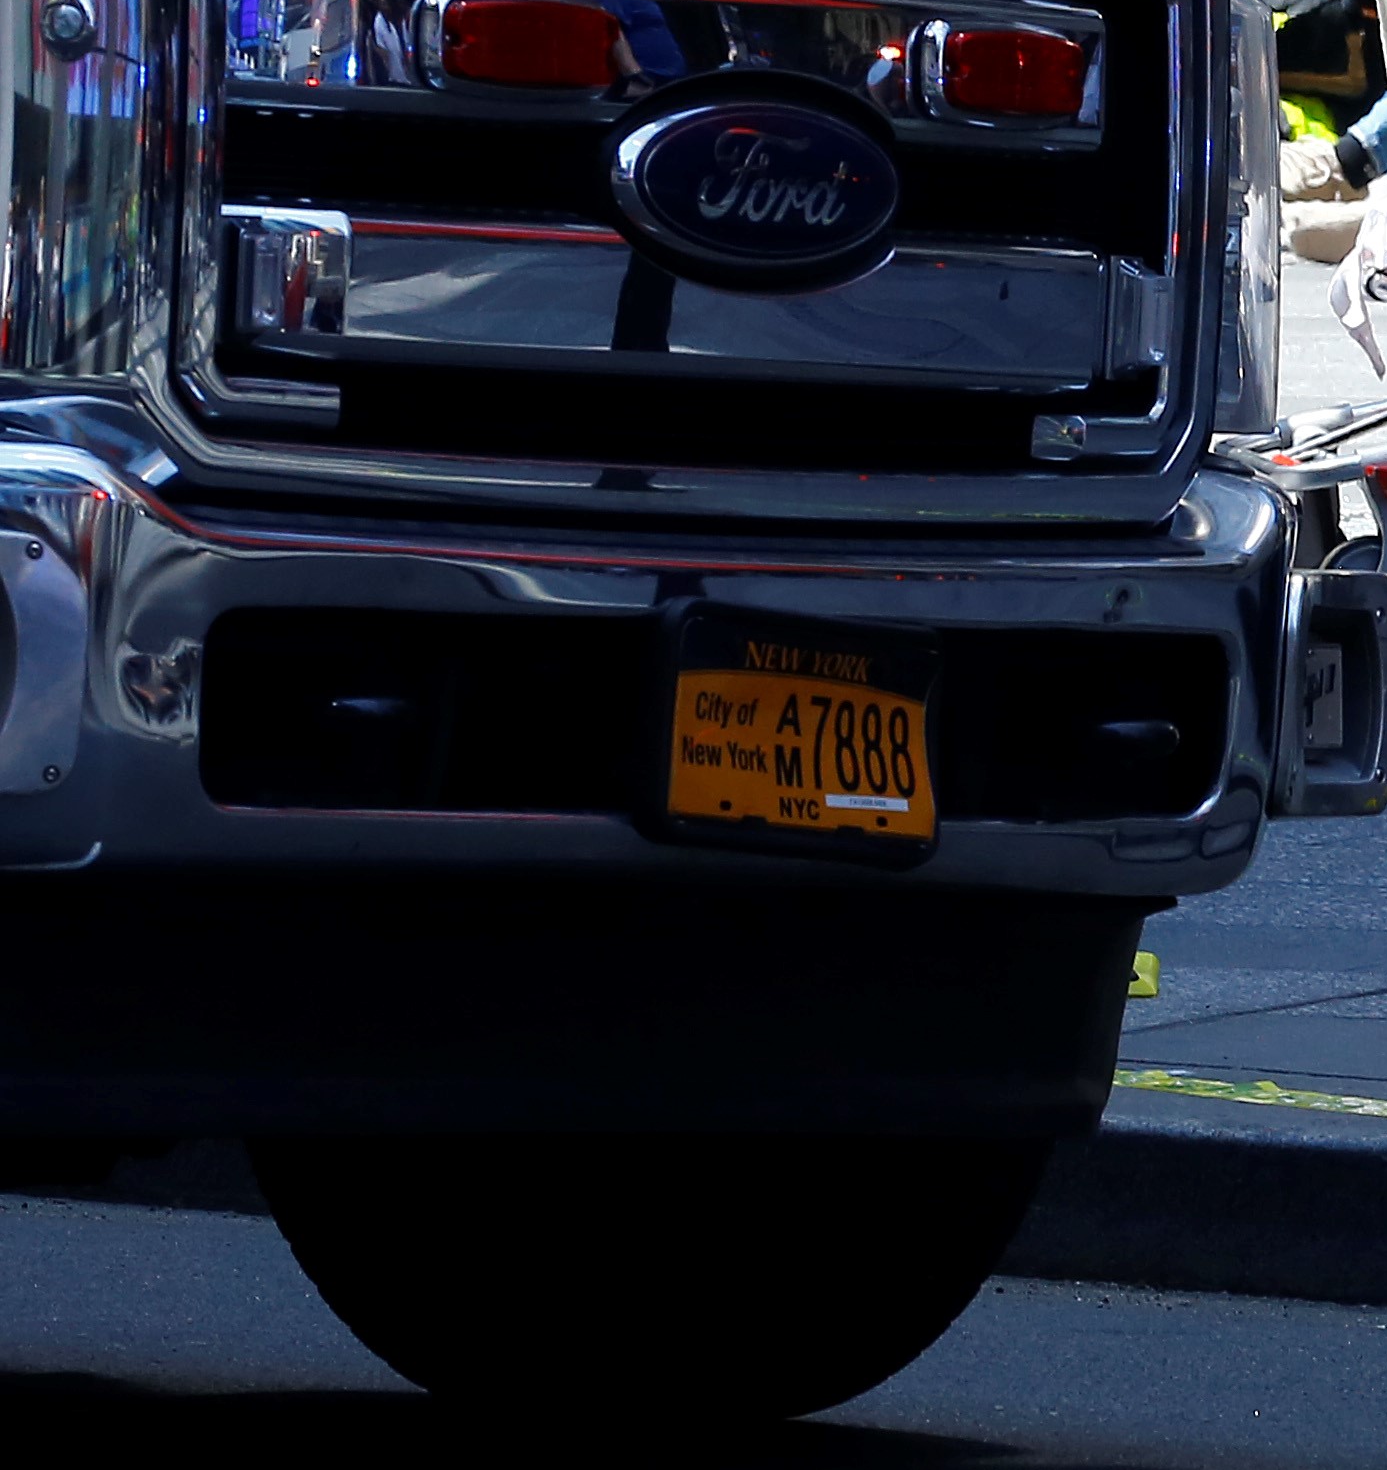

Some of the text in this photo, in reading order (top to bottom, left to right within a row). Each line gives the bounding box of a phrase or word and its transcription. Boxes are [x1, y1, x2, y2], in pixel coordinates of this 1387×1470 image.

[698, 126, 847, 227] Ford
[681, 735, 803, 789] New York M
[695, 691, 915, 798] City of A 7888
[779, 796, 820, 821] NYC
